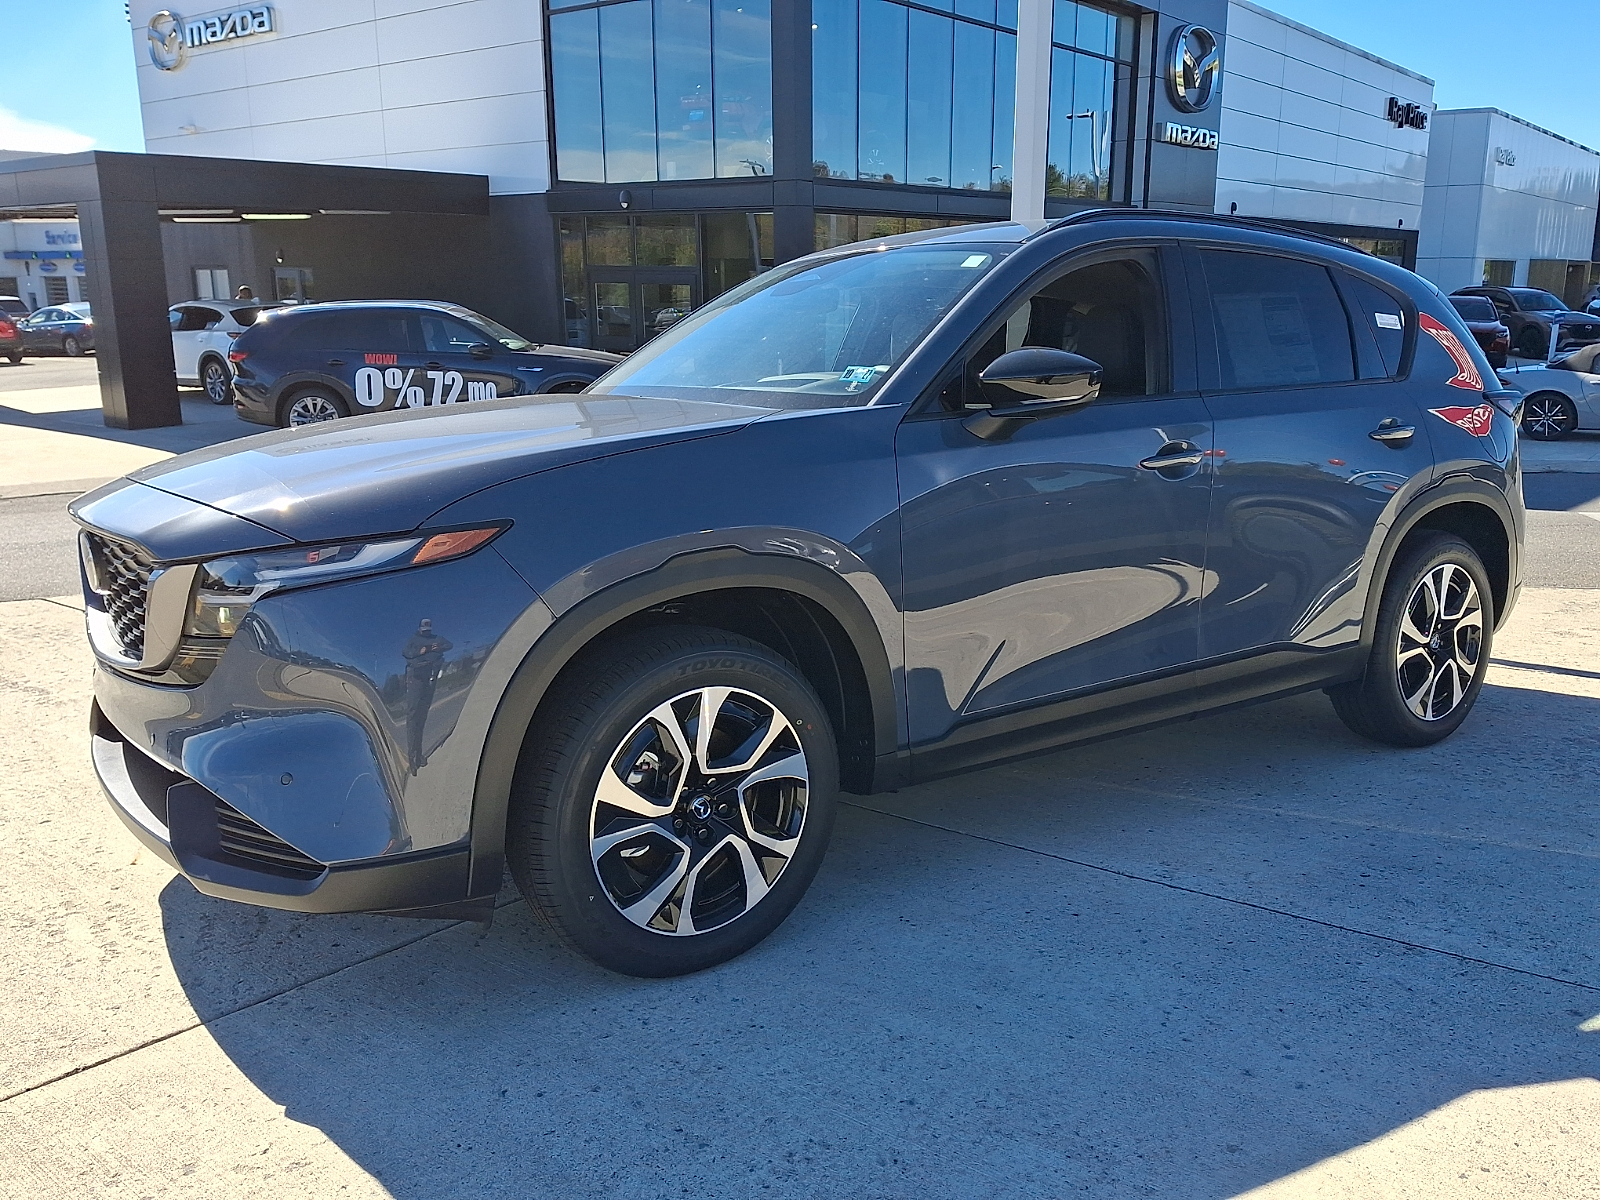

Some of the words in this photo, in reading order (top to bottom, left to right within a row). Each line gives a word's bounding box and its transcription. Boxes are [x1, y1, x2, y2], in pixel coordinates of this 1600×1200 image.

[185, 6, 276, 48] mazda
[1165, 121, 1219, 150] mazda
[364, 353, 398, 365] WOW!
[355, 366, 426, 409] 0%
[426, 370, 464, 407] 72
[678, 657, 736, 676] TOYO
